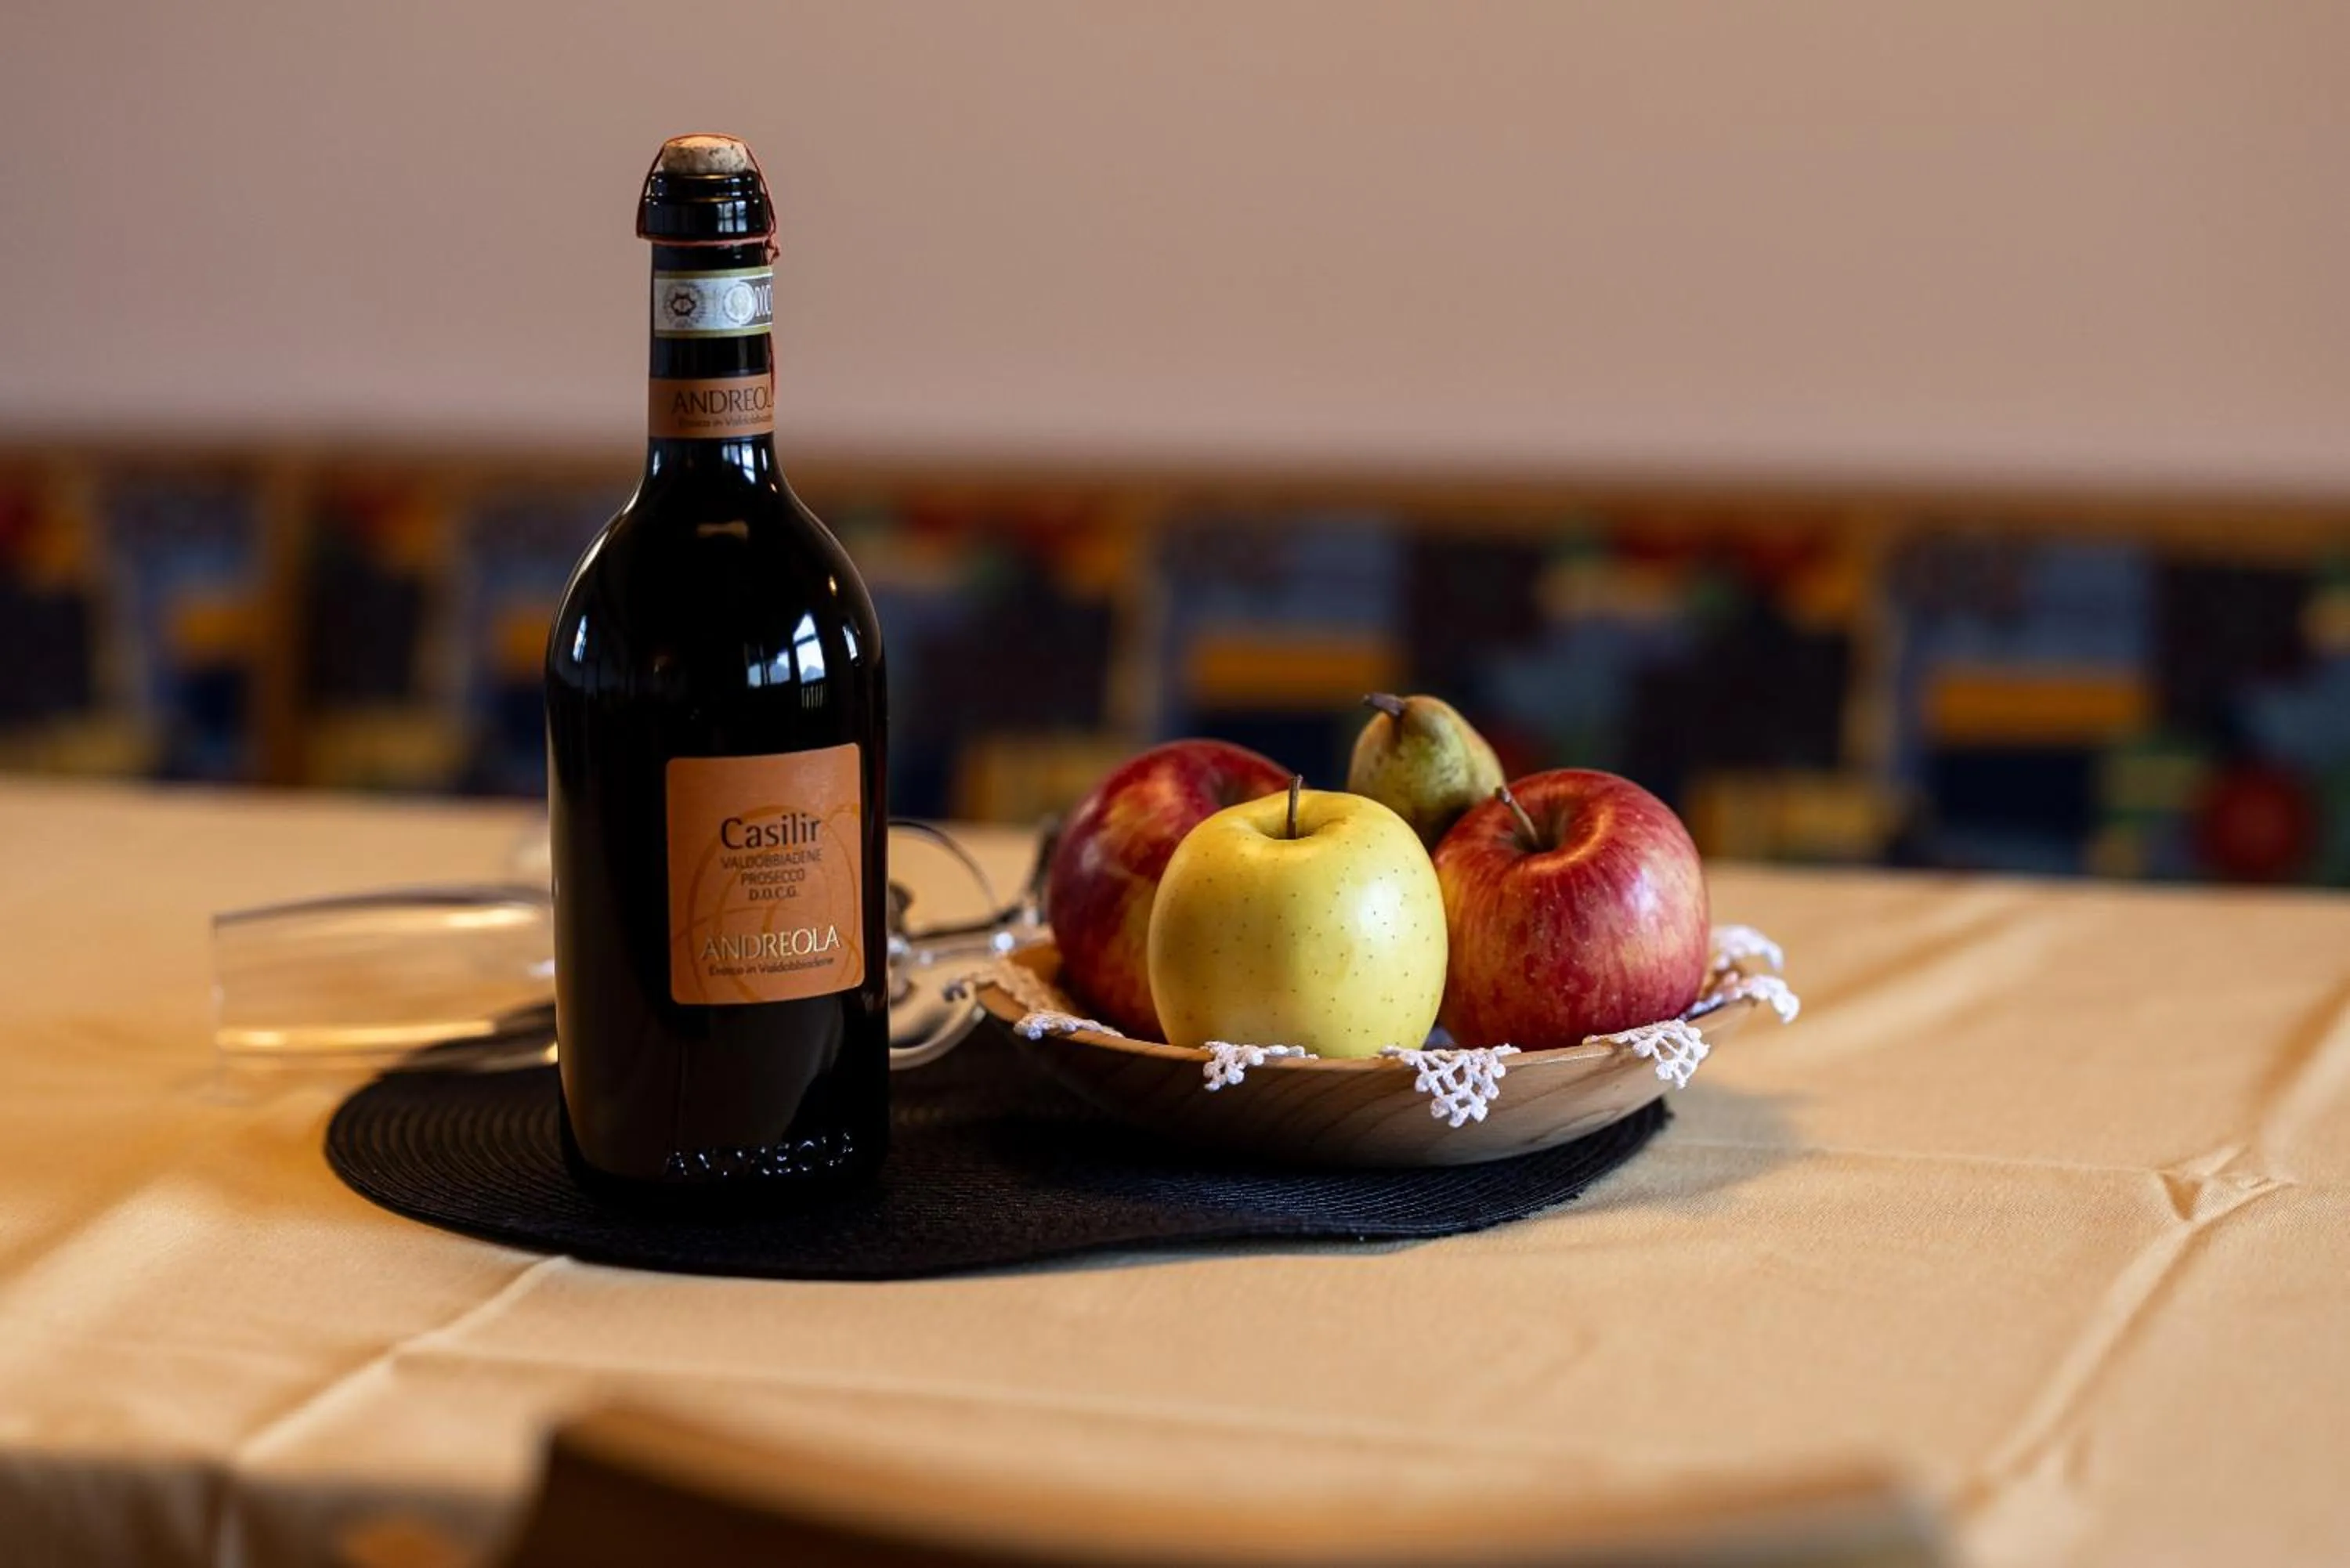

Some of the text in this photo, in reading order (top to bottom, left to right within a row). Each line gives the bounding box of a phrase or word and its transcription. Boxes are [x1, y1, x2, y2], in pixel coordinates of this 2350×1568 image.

[671, 386, 774, 414] ANDREOL
[721, 812, 821, 850] Casilir
[721, 848, 822, 869] VALDOBBIADENE
[740, 867, 805, 887] PROSECCO
[700, 924, 841, 961] ANDREOLA
